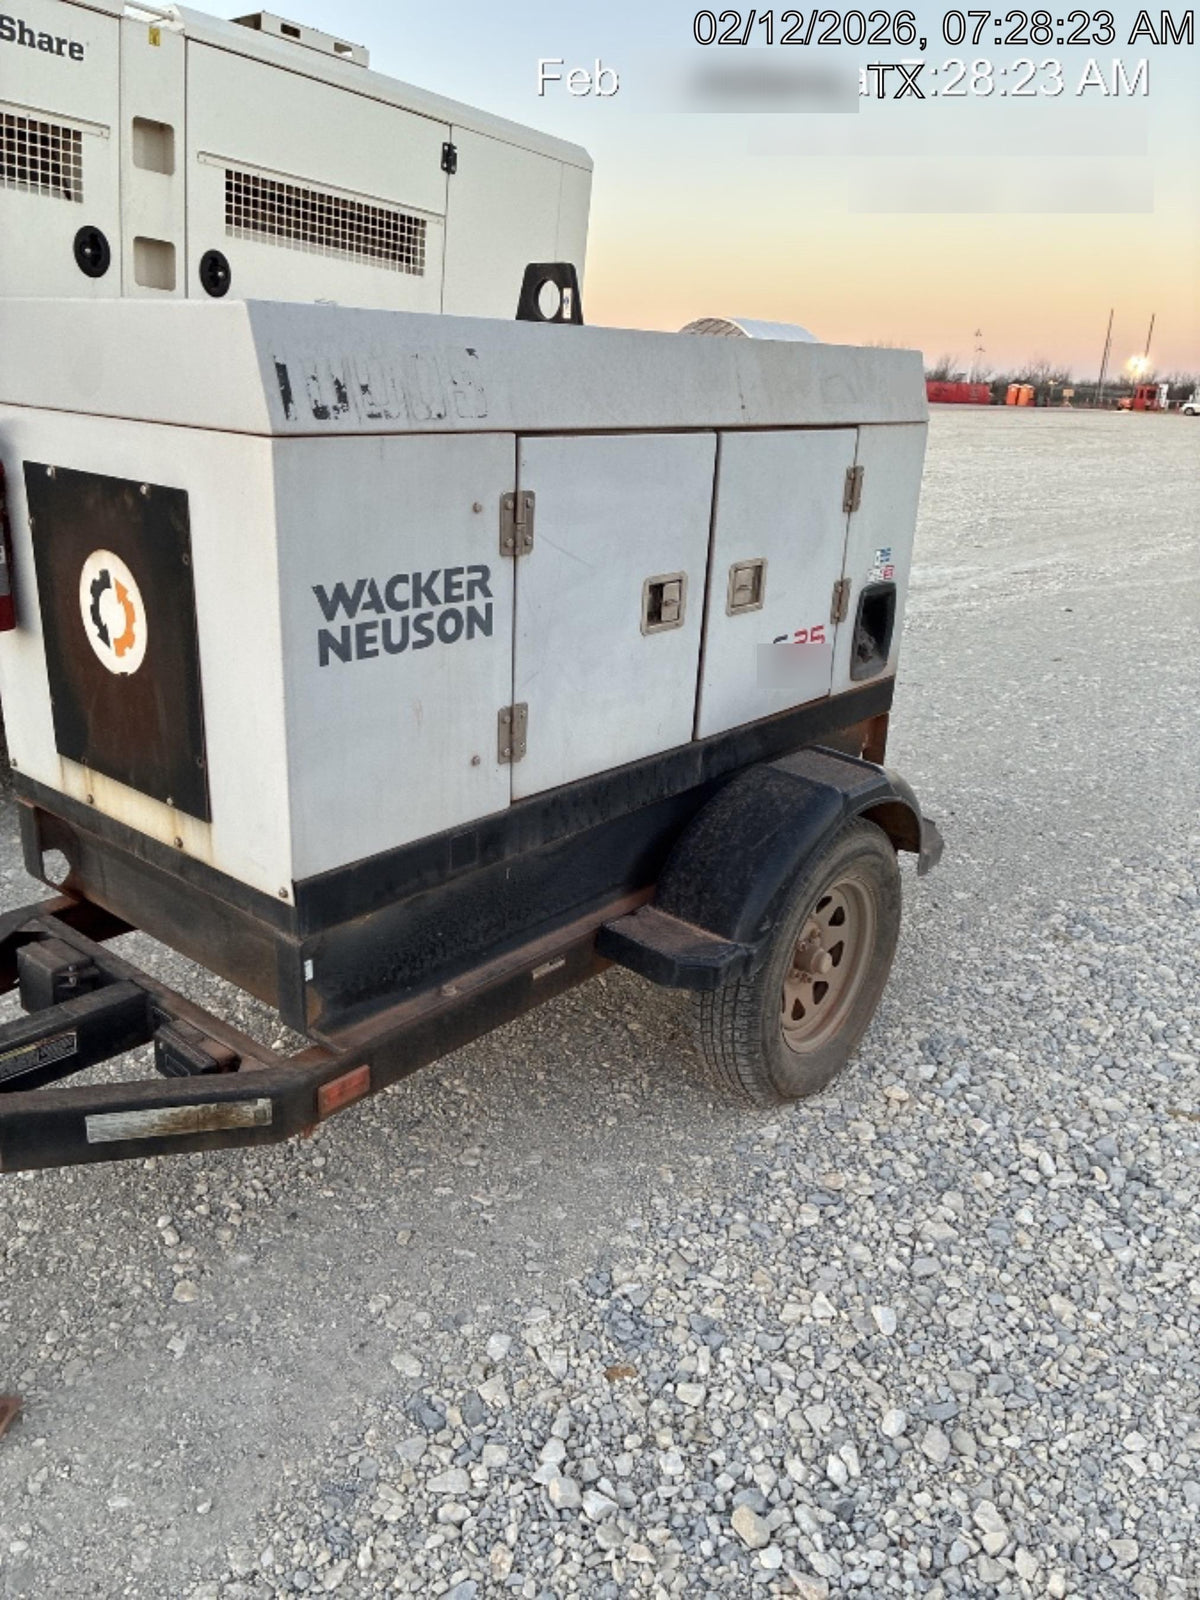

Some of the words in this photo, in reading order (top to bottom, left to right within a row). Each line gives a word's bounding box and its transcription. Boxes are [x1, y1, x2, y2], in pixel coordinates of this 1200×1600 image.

[0, 13, 84, 62] Share
[311, 564, 494, 622] WACKER
[317, 602, 494, 667] NEUSON
